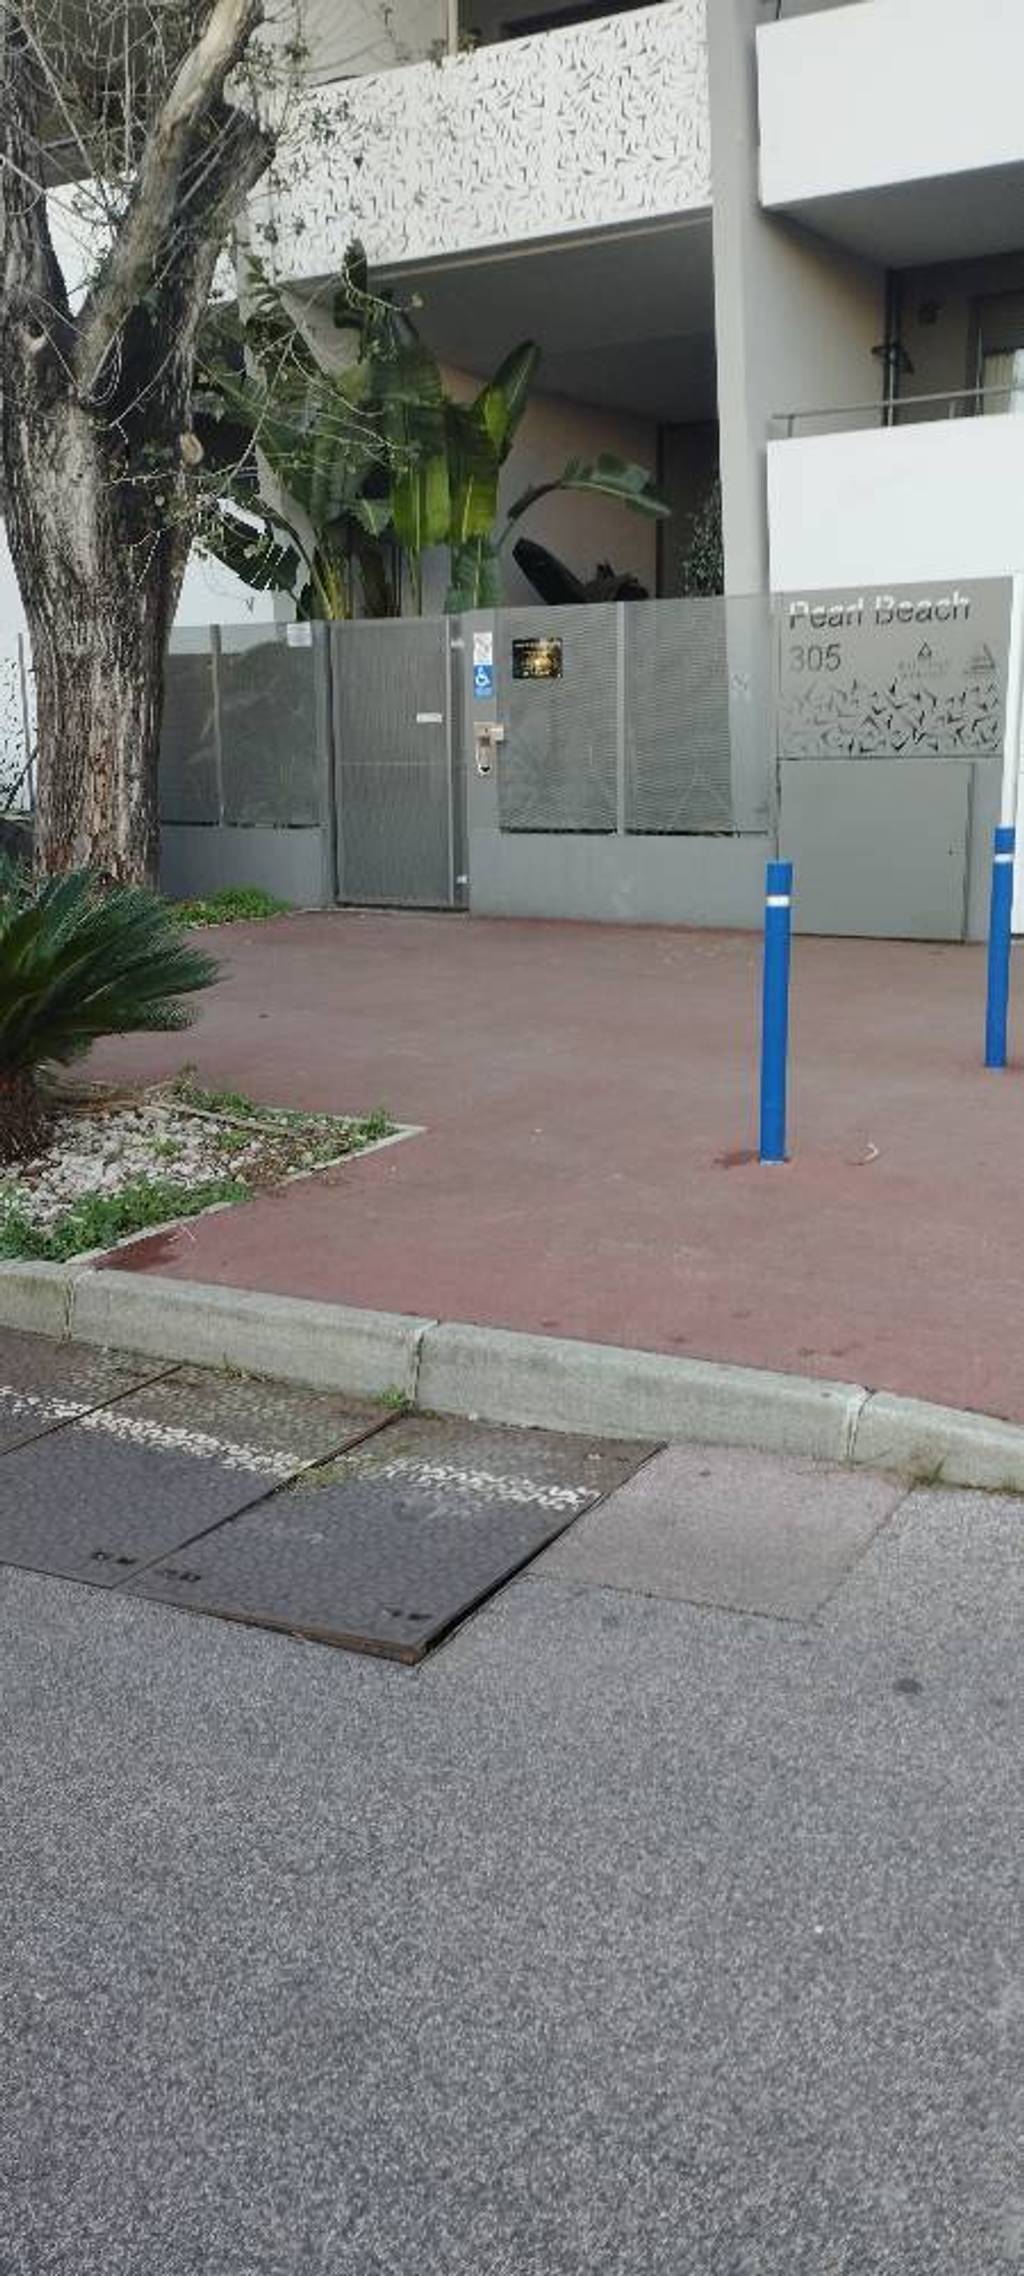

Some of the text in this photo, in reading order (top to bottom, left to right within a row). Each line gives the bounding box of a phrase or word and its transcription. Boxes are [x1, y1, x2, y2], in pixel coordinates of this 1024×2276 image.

[789, 590, 970, 630] Pearl Beach
[789, 643, 842, 673] 305
